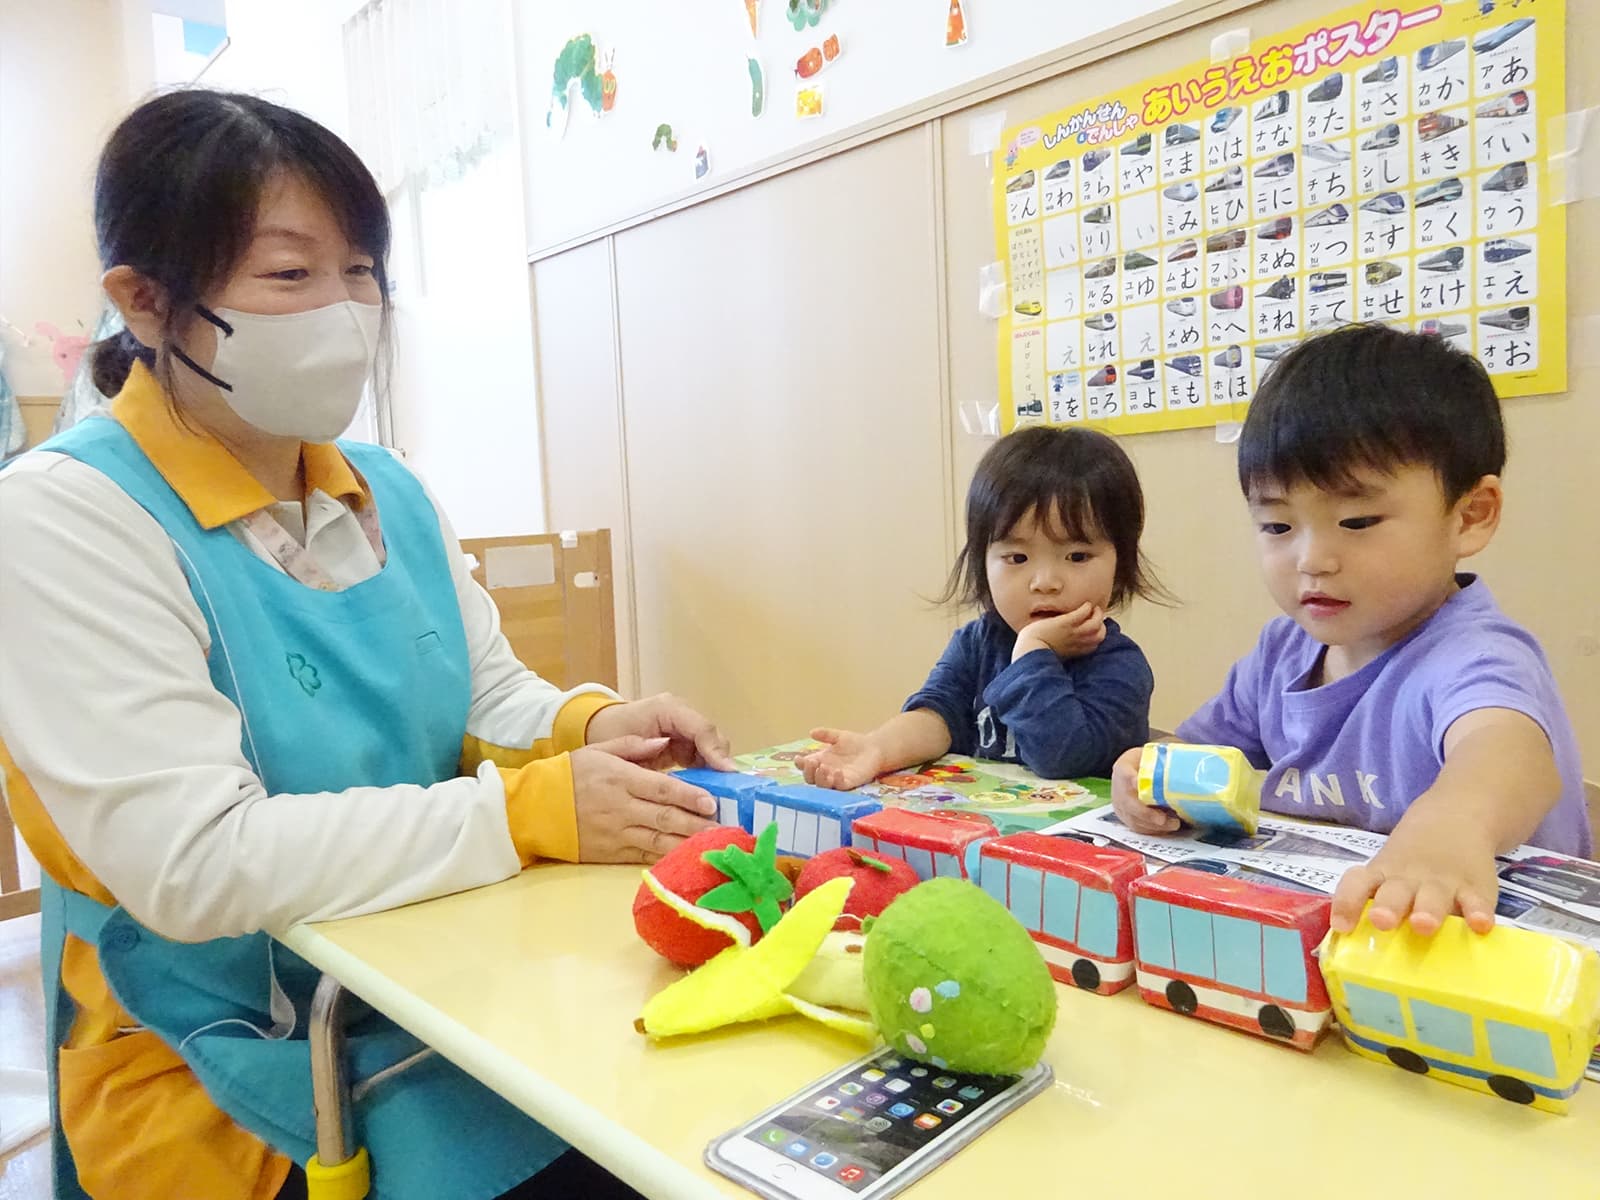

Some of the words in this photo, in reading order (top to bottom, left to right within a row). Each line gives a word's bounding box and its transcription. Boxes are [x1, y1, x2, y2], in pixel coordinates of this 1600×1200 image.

[1142, 5, 1442, 126] あいうえおポスター
[1481, 65, 1494, 79] ア
[1502, 56, 1528, 85] あ
[1418, 83, 1430, 97] カ
[1436, 76, 1464, 100] か
[1361, 99, 1372, 111] サ
[1380, 92, 1398, 116] さ
[1043, 100, 1127, 149] しんかんせん
[1307, 115, 1316, 128] タ
[1323, 107, 1344, 134] た
[1256, 130, 1266, 142] ナ
[1271, 124, 1292, 147] な
[1483, 135, 1494, 148] イ
[1501, 133, 1530, 153] い
[1208, 145, 1219, 155] ハ
[1223, 137, 1242, 162] は
[1420, 152, 1431, 163] キ
[1441, 144, 1460, 170] き
[1164, 159, 1173, 167] マ
[1180, 151, 1193, 174] ま
[1384, 159, 1400, 183] し
[1122, 170, 1131, 180] ヤ
[1135, 164, 1153, 184] や
[1363, 166, 1373, 178] シ
[1083, 181, 1090, 191] ラ
[1098, 176, 1110, 197] ら
[1308, 179, 1318, 191] チ
[1325, 171, 1345, 197] ち
[1045, 193, 1053, 201] ワ
[1057, 187, 1073, 207] わ
[1257, 192, 1267, 202] ニ
[1274, 187, 1293, 209] に
[1021, 197, 1036, 219] ん
[1210, 205, 1219, 215] ヒ
[1225, 198, 1244, 221] ひ
[1483, 205, 1496, 219] ウ
[1507, 198, 1524, 227] う
[1167, 215, 1174, 225] ミ
[1179, 210, 1198, 231] み
[1422, 219, 1433, 232] ク
[1446, 212, 1457, 237] く
[1086, 235, 1093, 246] リ
[1137, 224, 1154, 239] い
[1364, 231, 1375, 242] ス
[1380, 224, 1404, 249] す
[1100, 230, 1110, 252] り
[1310, 241, 1320, 254] ツ
[1325, 241, 1348, 256] つ
[1059, 244, 1075, 258] い
[1259, 252, 1269, 264] ヌ
[1272, 248, 1295, 269] ぬ
[1211, 262, 1220, 273] フ
[1223, 258, 1246, 279] ふ
[1125, 282, 1134, 290] ユ
[1138, 276, 1154, 297] ゆ
[1167, 273, 1176, 282] ム
[1180, 267, 1199, 289] む
[1483, 276, 1496, 288] エ
[1505, 270, 1529, 297] え
[1088, 290, 1096, 299] ル
[1100, 285, 1113, 305] る
[1420, 285, 1433, 298] ケ
[1440, 279, 1466, 305] け
[1065, 292, 1074, 313] う
[1309, 304, 1319, 316] テ
[1326, 300, 1346, 321] て
[1363, 296, 1374, 307] セ
[1379, 289, 1404, 314] せ
[1259, 312, 1268, 325] ネ
[1273, 309, 1295, 332] ね
[1140, 332, 1156, 353] え
[1168, 329, 1176, 338] メ
[1180, 326, 1199, 344] め
[1063, 345, 1076, 365] え
[1088, 344, 1096, 352] レ
[1100, 341, 1116, 358] れ
[1484, 344, 1496, 357] オ
[1504, 340, 1531, 367] お
[1171, 385, 1180, 396] モ
[1186, 381, 1199, 404] も
[1214, 380, 1223, 390] ホ
[1229, 375, 1248, 398] ほ
[1090, 397, 1098, 405] ロ
[1103, 392, 1117, 413] ろ
[1130, 392, 1137, 400] ヨ
[1142, 387, 1157, 408] よ
[1066, 397, 1079, 418] を
